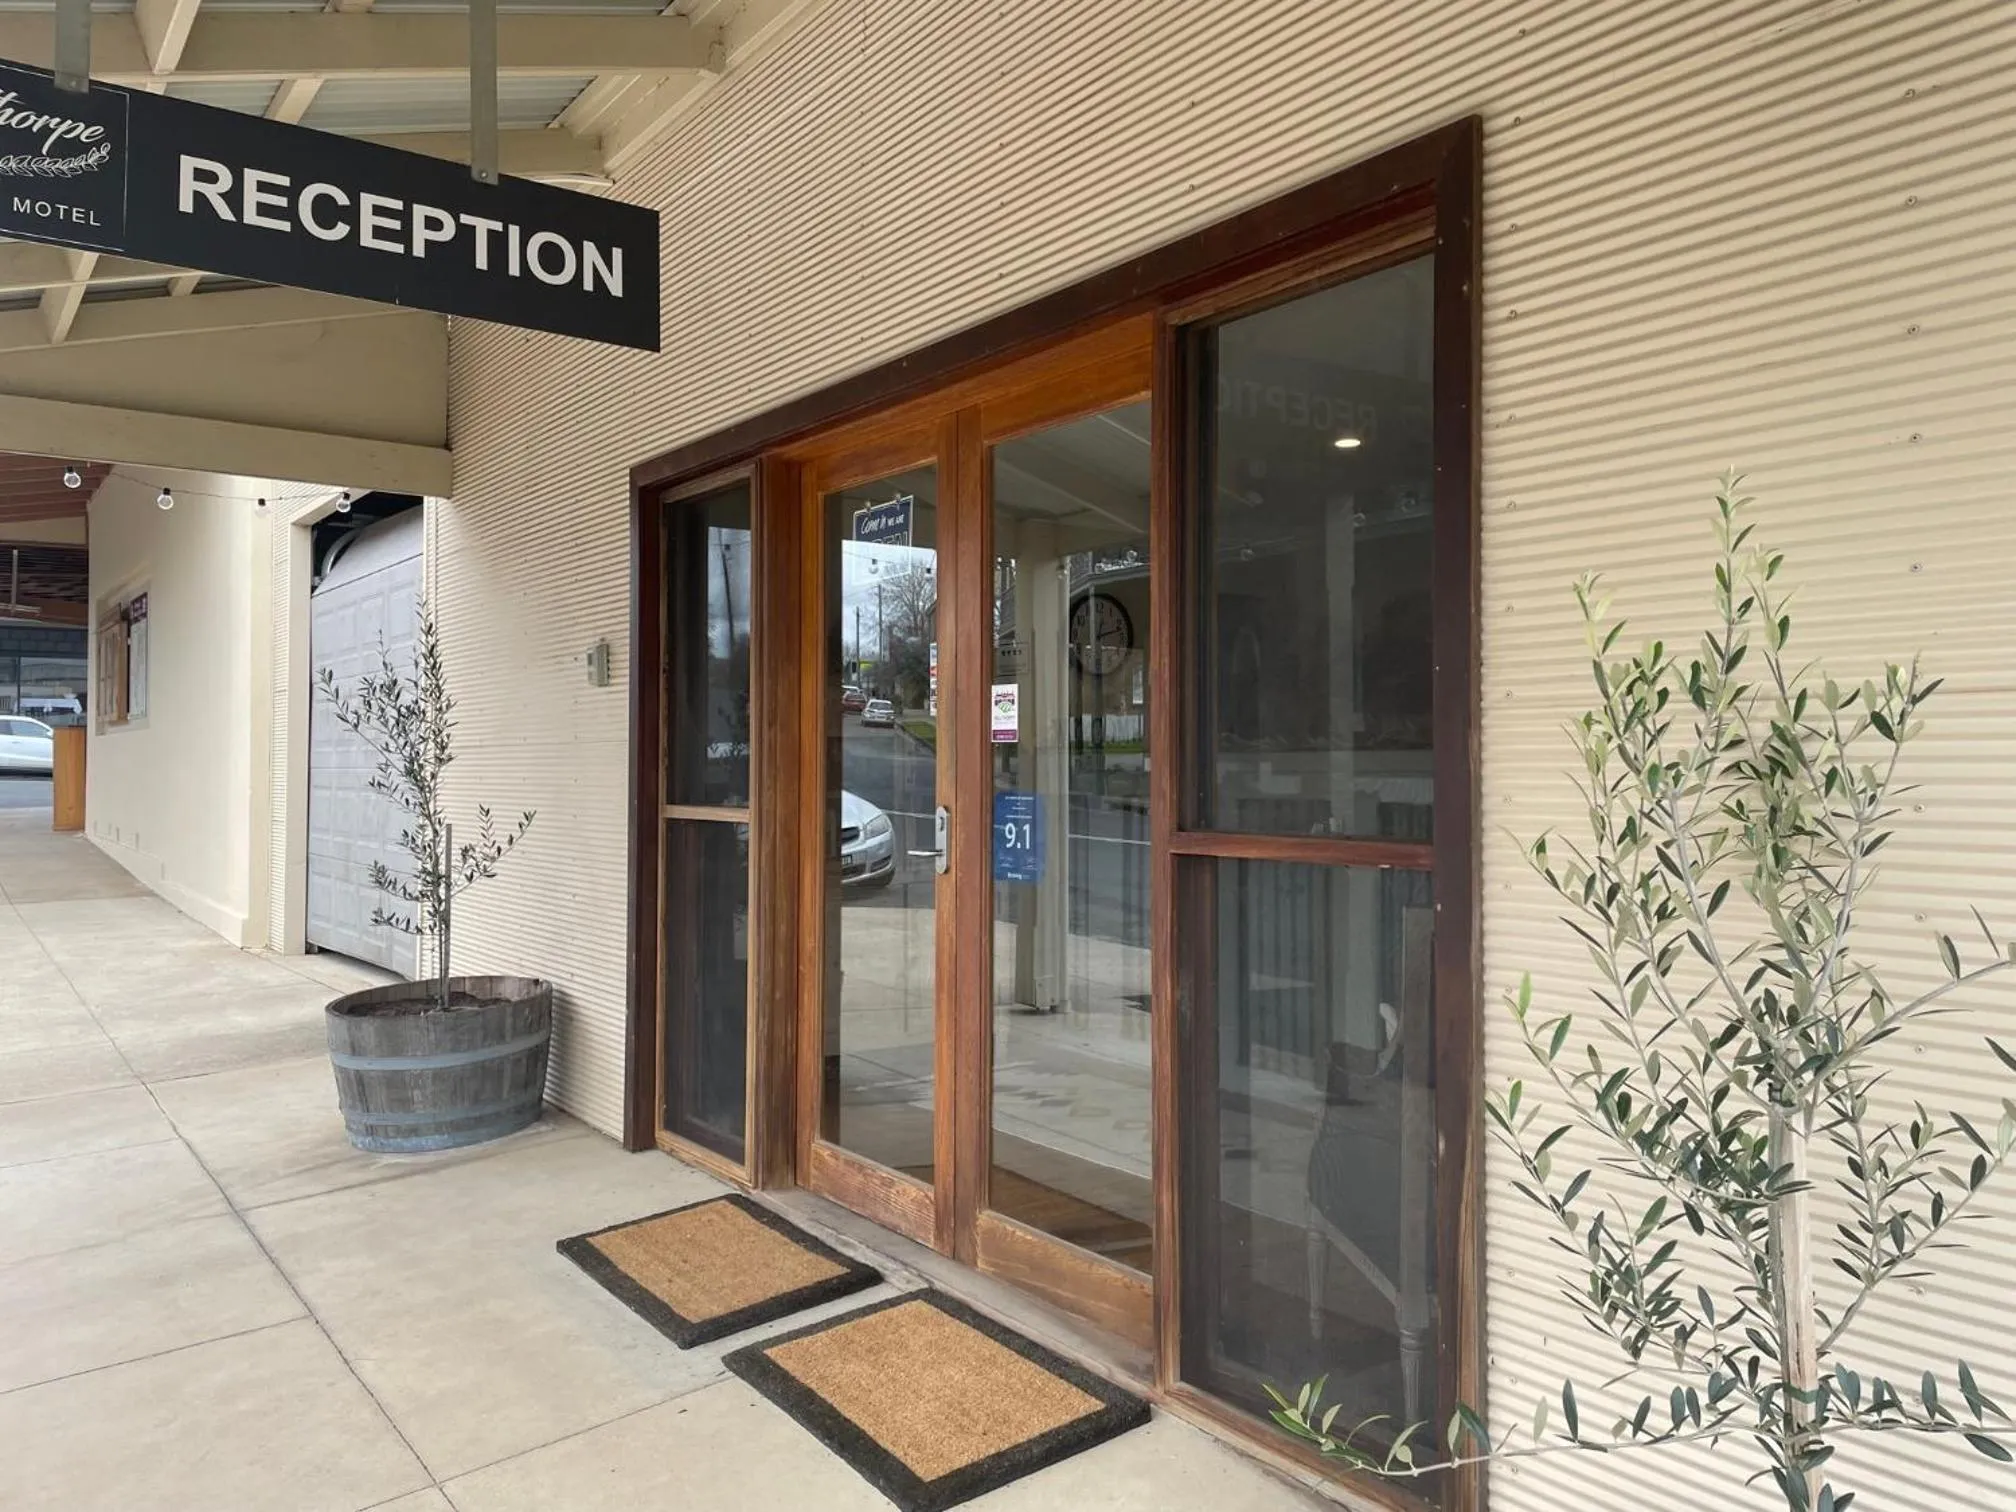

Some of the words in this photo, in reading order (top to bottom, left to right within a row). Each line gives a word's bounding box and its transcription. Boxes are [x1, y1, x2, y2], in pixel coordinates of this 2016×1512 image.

[0, 88, 106, 156] horpe
[13, 197, 102, 227] MOTEL
[178, 153, 624, 298] RECEPTION
[1005, 822, 1031, 850] 9.1
